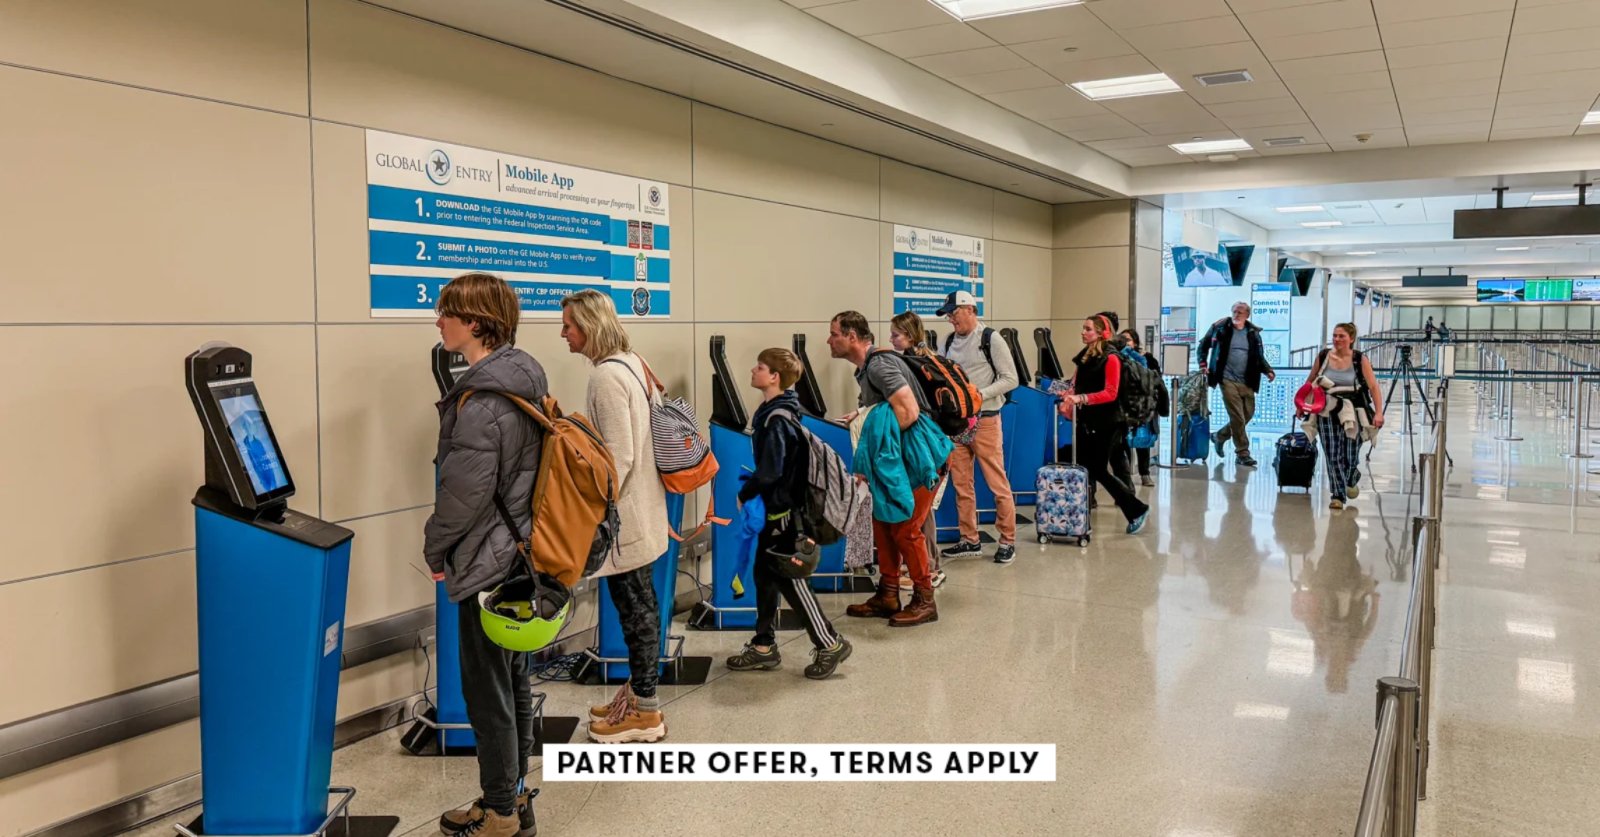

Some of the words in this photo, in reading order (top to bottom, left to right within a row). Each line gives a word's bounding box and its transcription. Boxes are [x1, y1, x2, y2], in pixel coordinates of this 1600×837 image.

[376, 153, 424, 172] GLOBAL
[456, 166, 493, 182] ENTRY
[506, 164, 548, 184] Mobile
[551, 172, 574, 190] App
[506, 184, 536, 196] advanced
[538, 188, 559, 198] arrival
[560, 192, 590, 204] processing
[597, 199, 610, 207] your
[610, 198, 635, 210] fingertips
[415, 198, 430, 218] 1.
[436, 200, 480, 212] DOWNLOAD
[481, 204, 492, 214] the
[492, 206, 502, 214] GE
[503, 208, 524, 217] Mobile
[525, 210, 538, 219] App
[538, 212, 546, 221] by
[546, 214, 570, 224] scanning
[580, 217, 589, 226] QR
[436, 211, 453, 220] prior
[454, 212, 462, 220] to
[464, 215, 491, 226] entering
[492, 216, 502, 225] the
[504, 218, 526, 228] Federal
[526, 220, 556, 230] Inspection
[556, 224, 574, 232] Service
[576, 226, 589, 235] Area.
[416, 240, 432, 260] 2.
[438, 242, 466, 252] SUBMIT
[468, 244, 474, 252] A
[474, 246, 498, 254] PHOTO
[508, 248, 518, 256] the
[530, 250, 550, 258] Mobile
[550, 252, 562, 260] App
[570, 254, 584, 262] verify
[438, 254, 479, 264] membership
[480, 256, 493, 265] and
[494, 258, 513, 266] arrival
[514, 258, 526, 266] into
[528, 259, 538, 268] the
[416, 284, 432, 304] 3.
[549, 288, 573, 296] OFFICER
